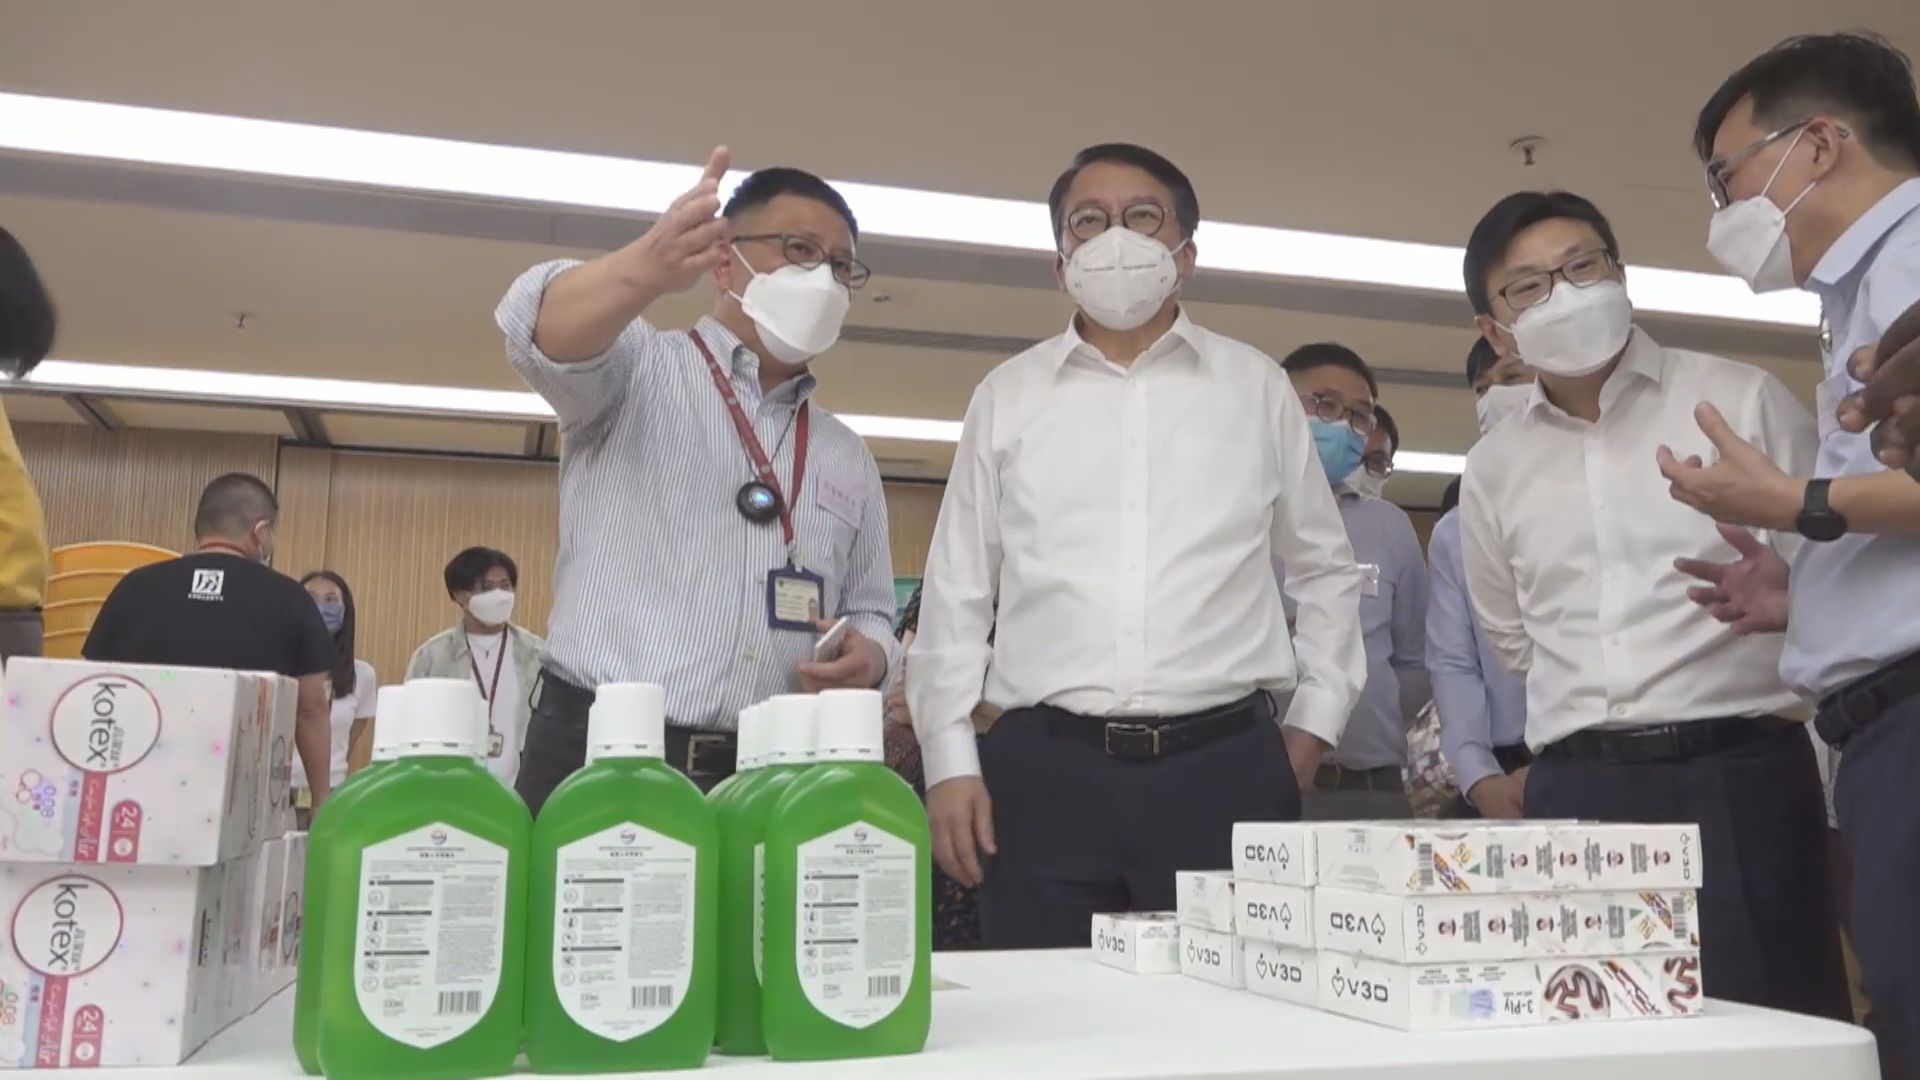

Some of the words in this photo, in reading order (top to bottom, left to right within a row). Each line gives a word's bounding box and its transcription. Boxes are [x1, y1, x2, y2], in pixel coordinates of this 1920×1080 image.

[86, 682, 127, 764] kotex
[119, 806, 138, 829] 24
[47, 883, 89, 967] kotex
[1347, 978, 1389, 1003] V3D
[1504, 997, 1533, 1015] 3-Ply
[82, 1009, 99, 1032] 24
